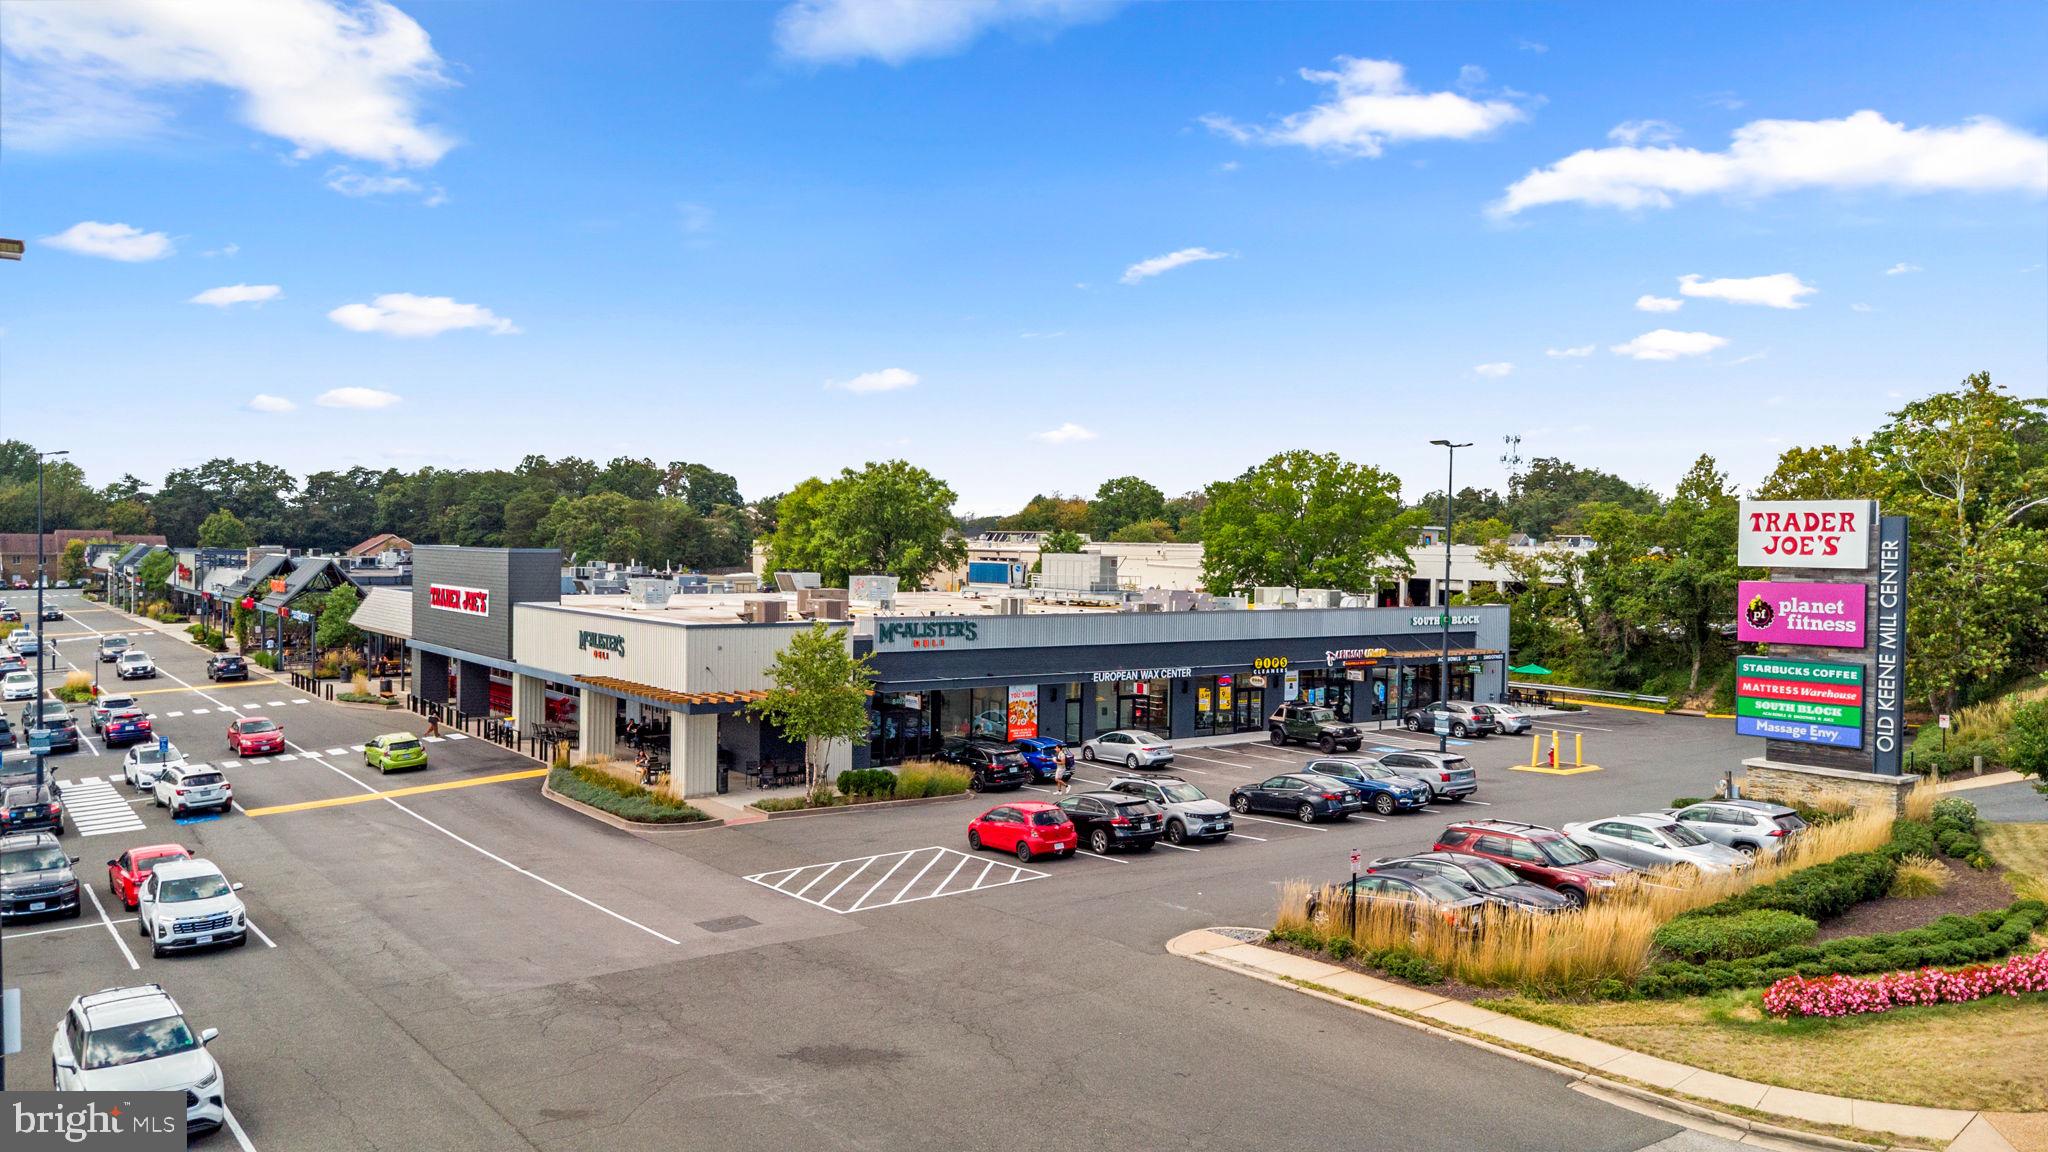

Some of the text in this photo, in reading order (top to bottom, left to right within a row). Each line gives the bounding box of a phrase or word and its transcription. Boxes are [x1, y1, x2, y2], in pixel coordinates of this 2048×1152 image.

[1749, 512, 1856, 533] TRADER
[1761, 534, 1842, 556] JOE'S
[1778, 597, 1845, 616] planet
[1412, 615, 1480, 626] SOUTH BLOCK
[1786, 613, 1857, 632] fitness
[1876, 540, 1899, 753] OLD KEENE MILL CENTER
[1253, 667, 1288, 675] CLEANERS
[1254, 657, 1288, 669] ZIPS
[1742, 663, 1858, 680] STARBUCKS COFFEE
[1093, 668, 1192, 682] EUROPEAN WAX CENTER
[1742, 682, 1857, 701] MATTRESS Warehouse
[1754, 700, 1843, 717] SOUTH BLOCK
[1756, 719, 1840, 742] Massage Envy
